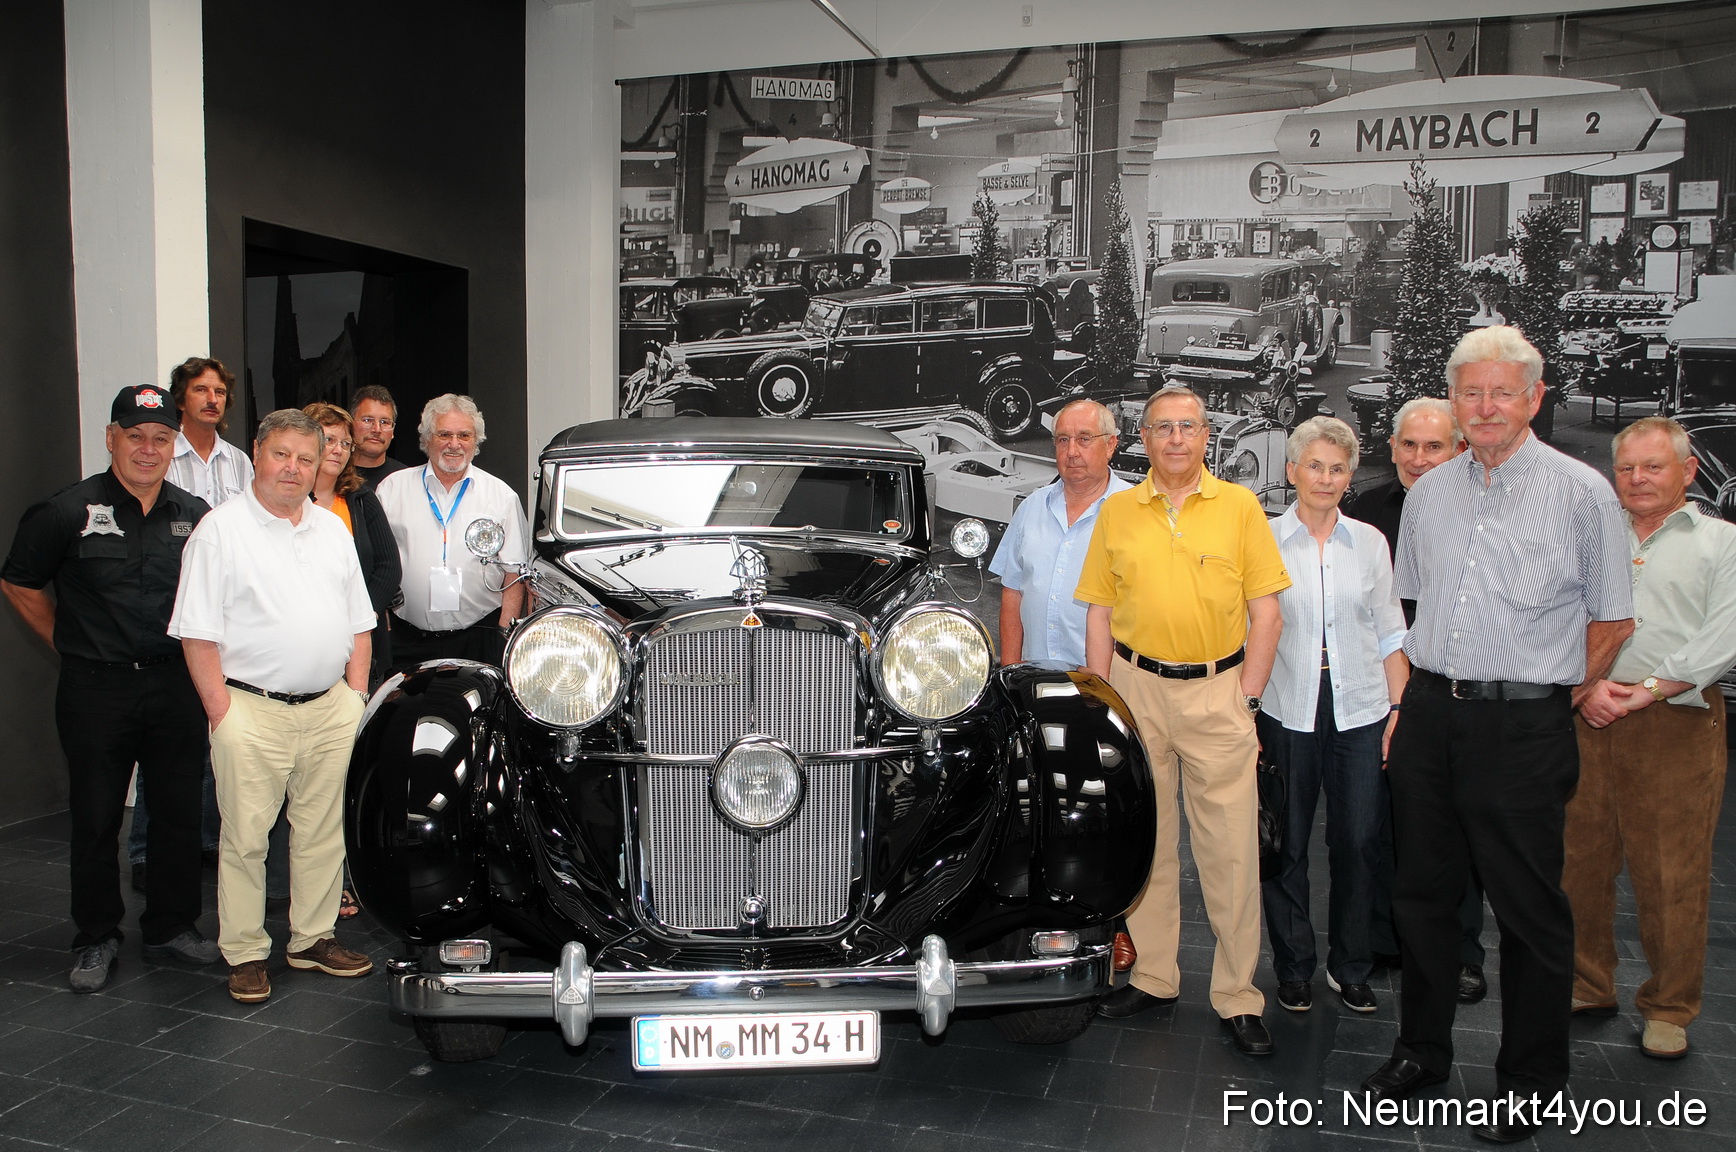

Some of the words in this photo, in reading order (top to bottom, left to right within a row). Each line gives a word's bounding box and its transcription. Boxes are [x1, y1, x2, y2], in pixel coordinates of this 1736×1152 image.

[1447, 31, 1456, 52] 2
[755, 79, 832, 99] HANOMAG
[788, 113, 796, 126] 4
[1309, 129, 1320, 147] 2
[1356, 108, 1539, 152] MAYBACH
[1585, 112, 1600, 134] 2
[734, 175, 740, 187] 4
[751, 159, 830, 190] HANOMAG
[842, 161, 850, 174] 4
[982, 177, 1003, 190] BASSE
[1003, 179, 1009, 188] &
[1010, 175, 1029, 187] SELVE
[645, 1046, 655, 1059] D
[670, 1025, 712, 1058] NM
[738, 1022, 780, 1056] MM
[791, 1021, 831, 1055] 34
[845, 1020, 864, 1052] H
